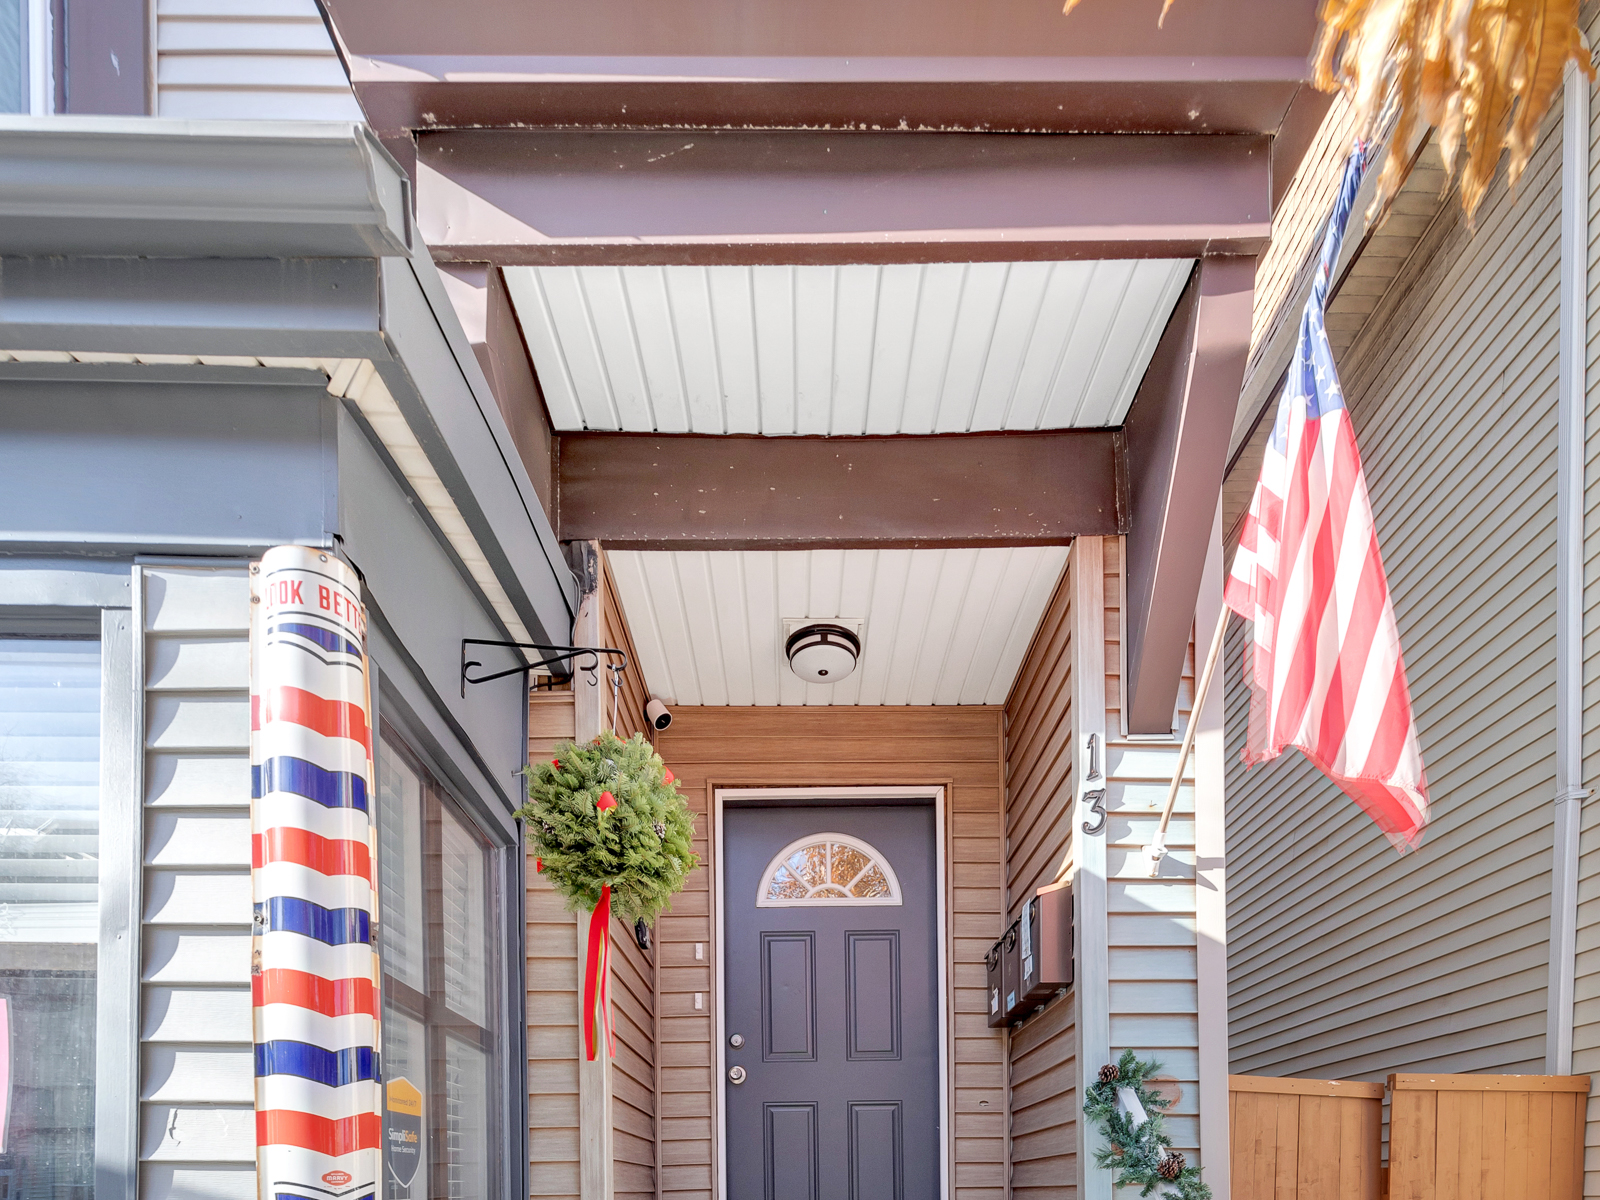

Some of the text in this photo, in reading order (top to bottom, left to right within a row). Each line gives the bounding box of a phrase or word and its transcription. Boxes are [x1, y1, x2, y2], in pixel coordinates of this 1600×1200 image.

[388, 1127, 417, 1144] SimpliSafe
[391, 1145, 415, 1155] Home Security
